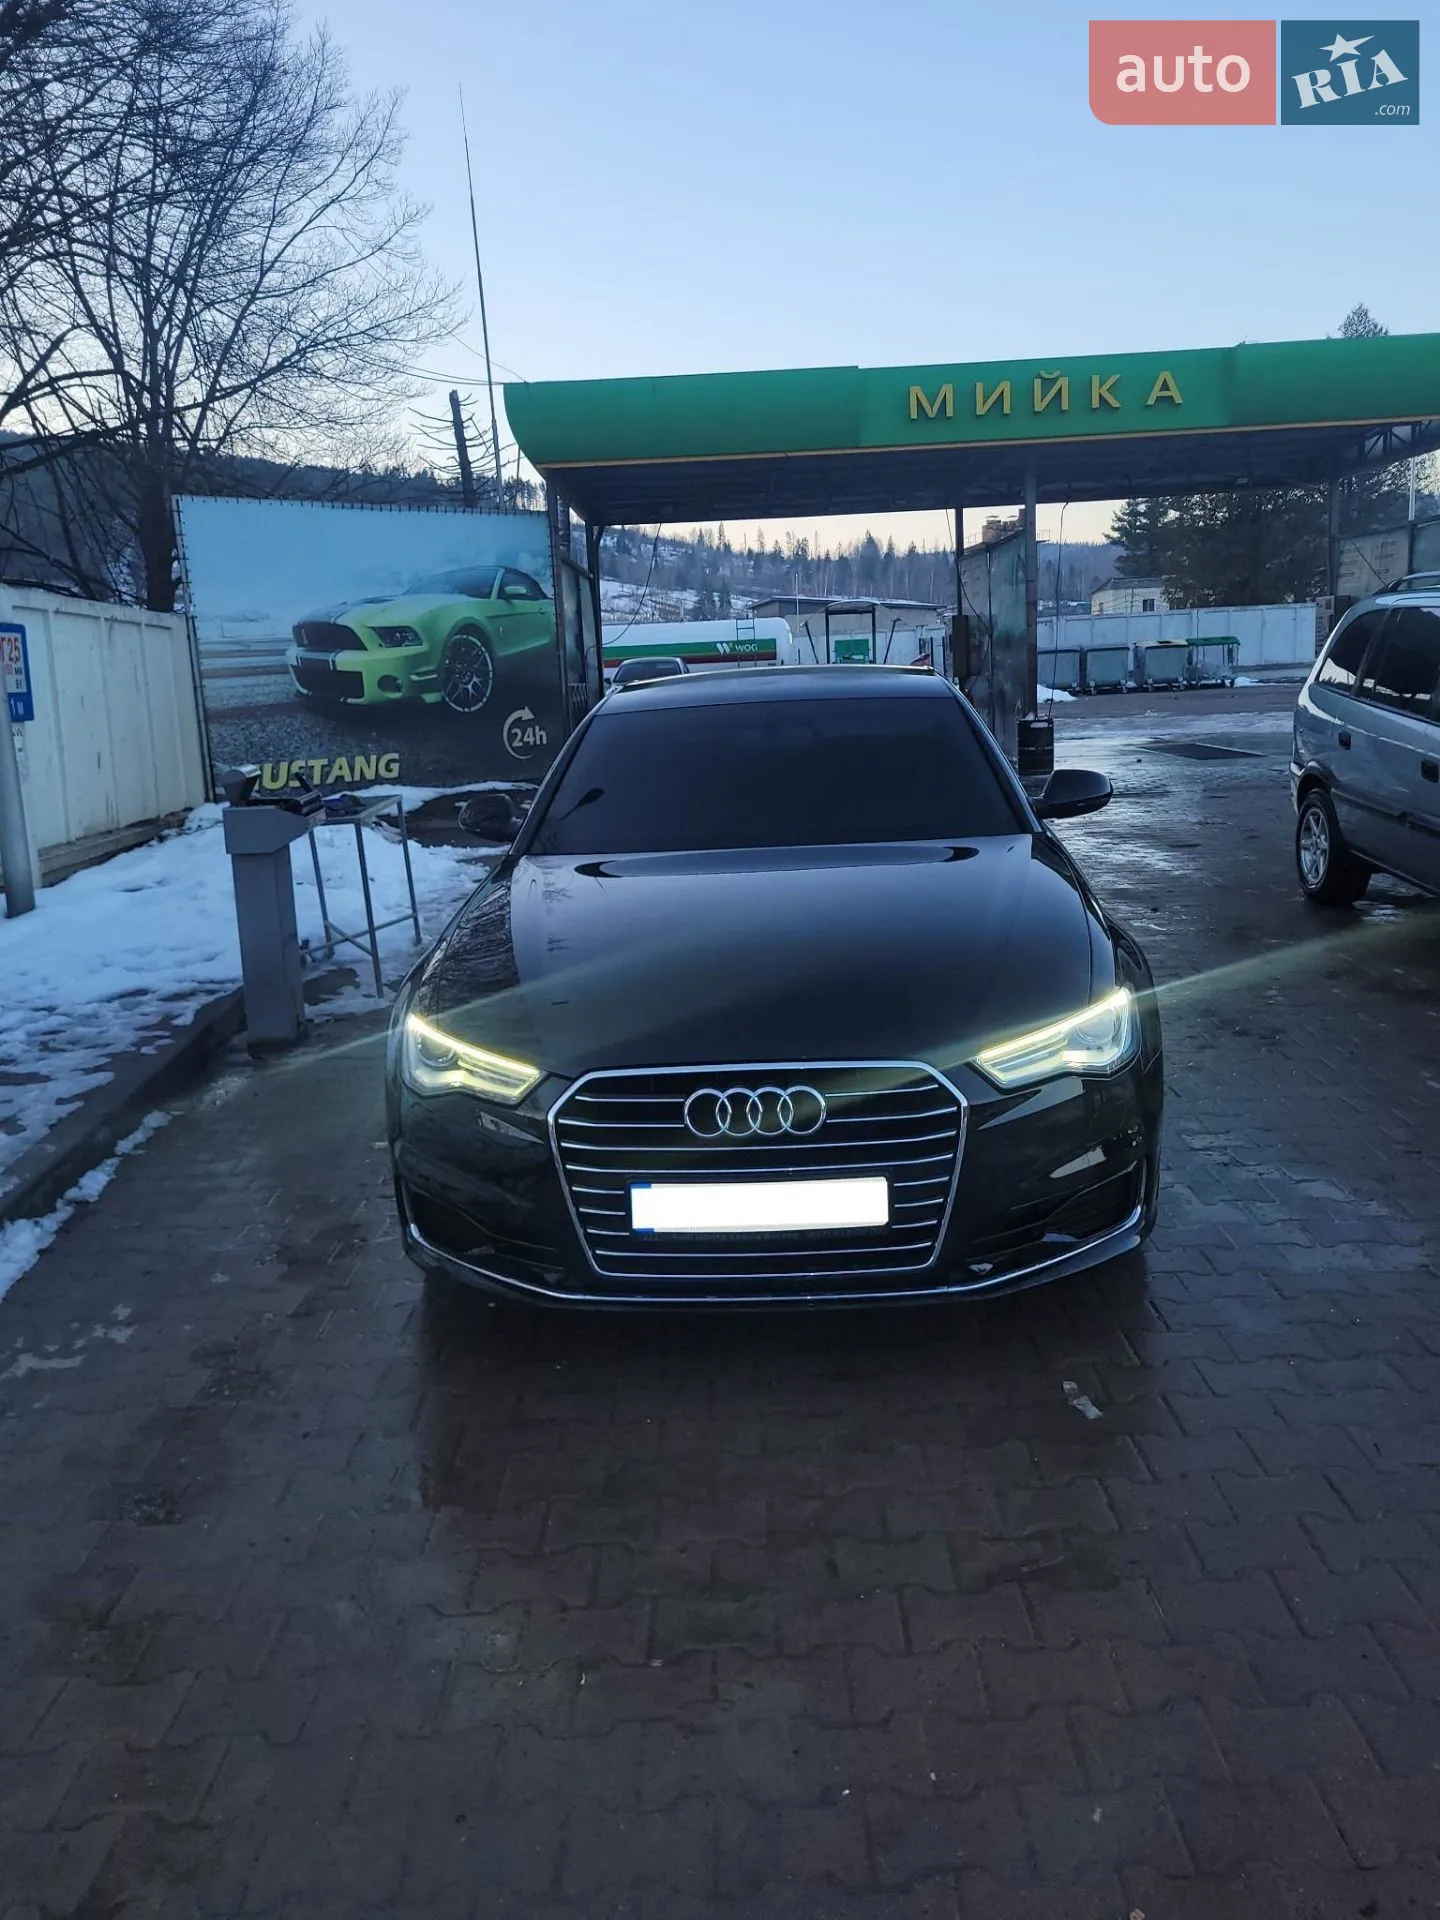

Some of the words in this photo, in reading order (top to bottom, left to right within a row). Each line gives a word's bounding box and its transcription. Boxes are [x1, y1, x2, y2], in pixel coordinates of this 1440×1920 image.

[909, 370, 1184, 420] МИЙКА
[511, 725, 548, 748] 24h
[253, 752, 400, 792] USTANG
